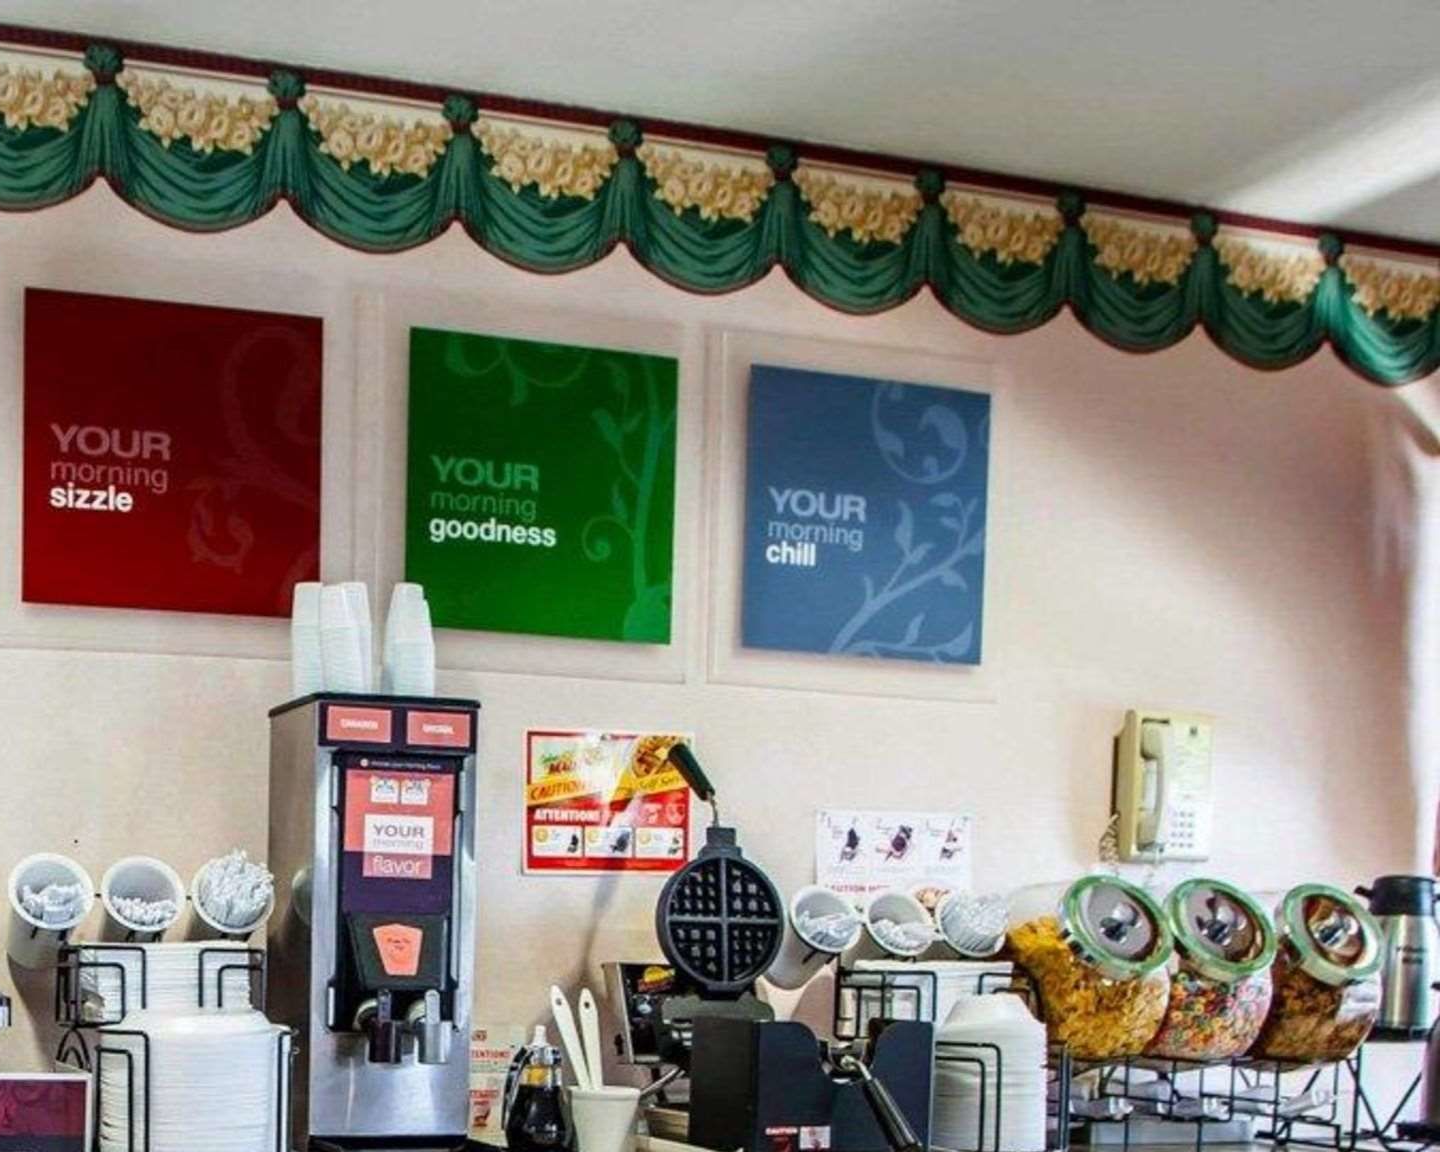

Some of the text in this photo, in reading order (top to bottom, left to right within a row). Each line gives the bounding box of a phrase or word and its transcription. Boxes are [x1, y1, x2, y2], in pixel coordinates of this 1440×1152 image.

[50, 423, 171, 460] YOUR
[50, 461, 168, 494] morning
[431, 455, 540, 491] YOUR
[50, 482, 133, 512] sizzle
[431, 491, 537, 523] morning
[768, 487, 867, 522] YOUR
[429, 517, 557, 547] goodness
[768, 521, 864, 552] morning
[765, 540, 817, 566] chill
[373, 824, 425, 838] YOUR
[372, 855, 421, 875] flavor
